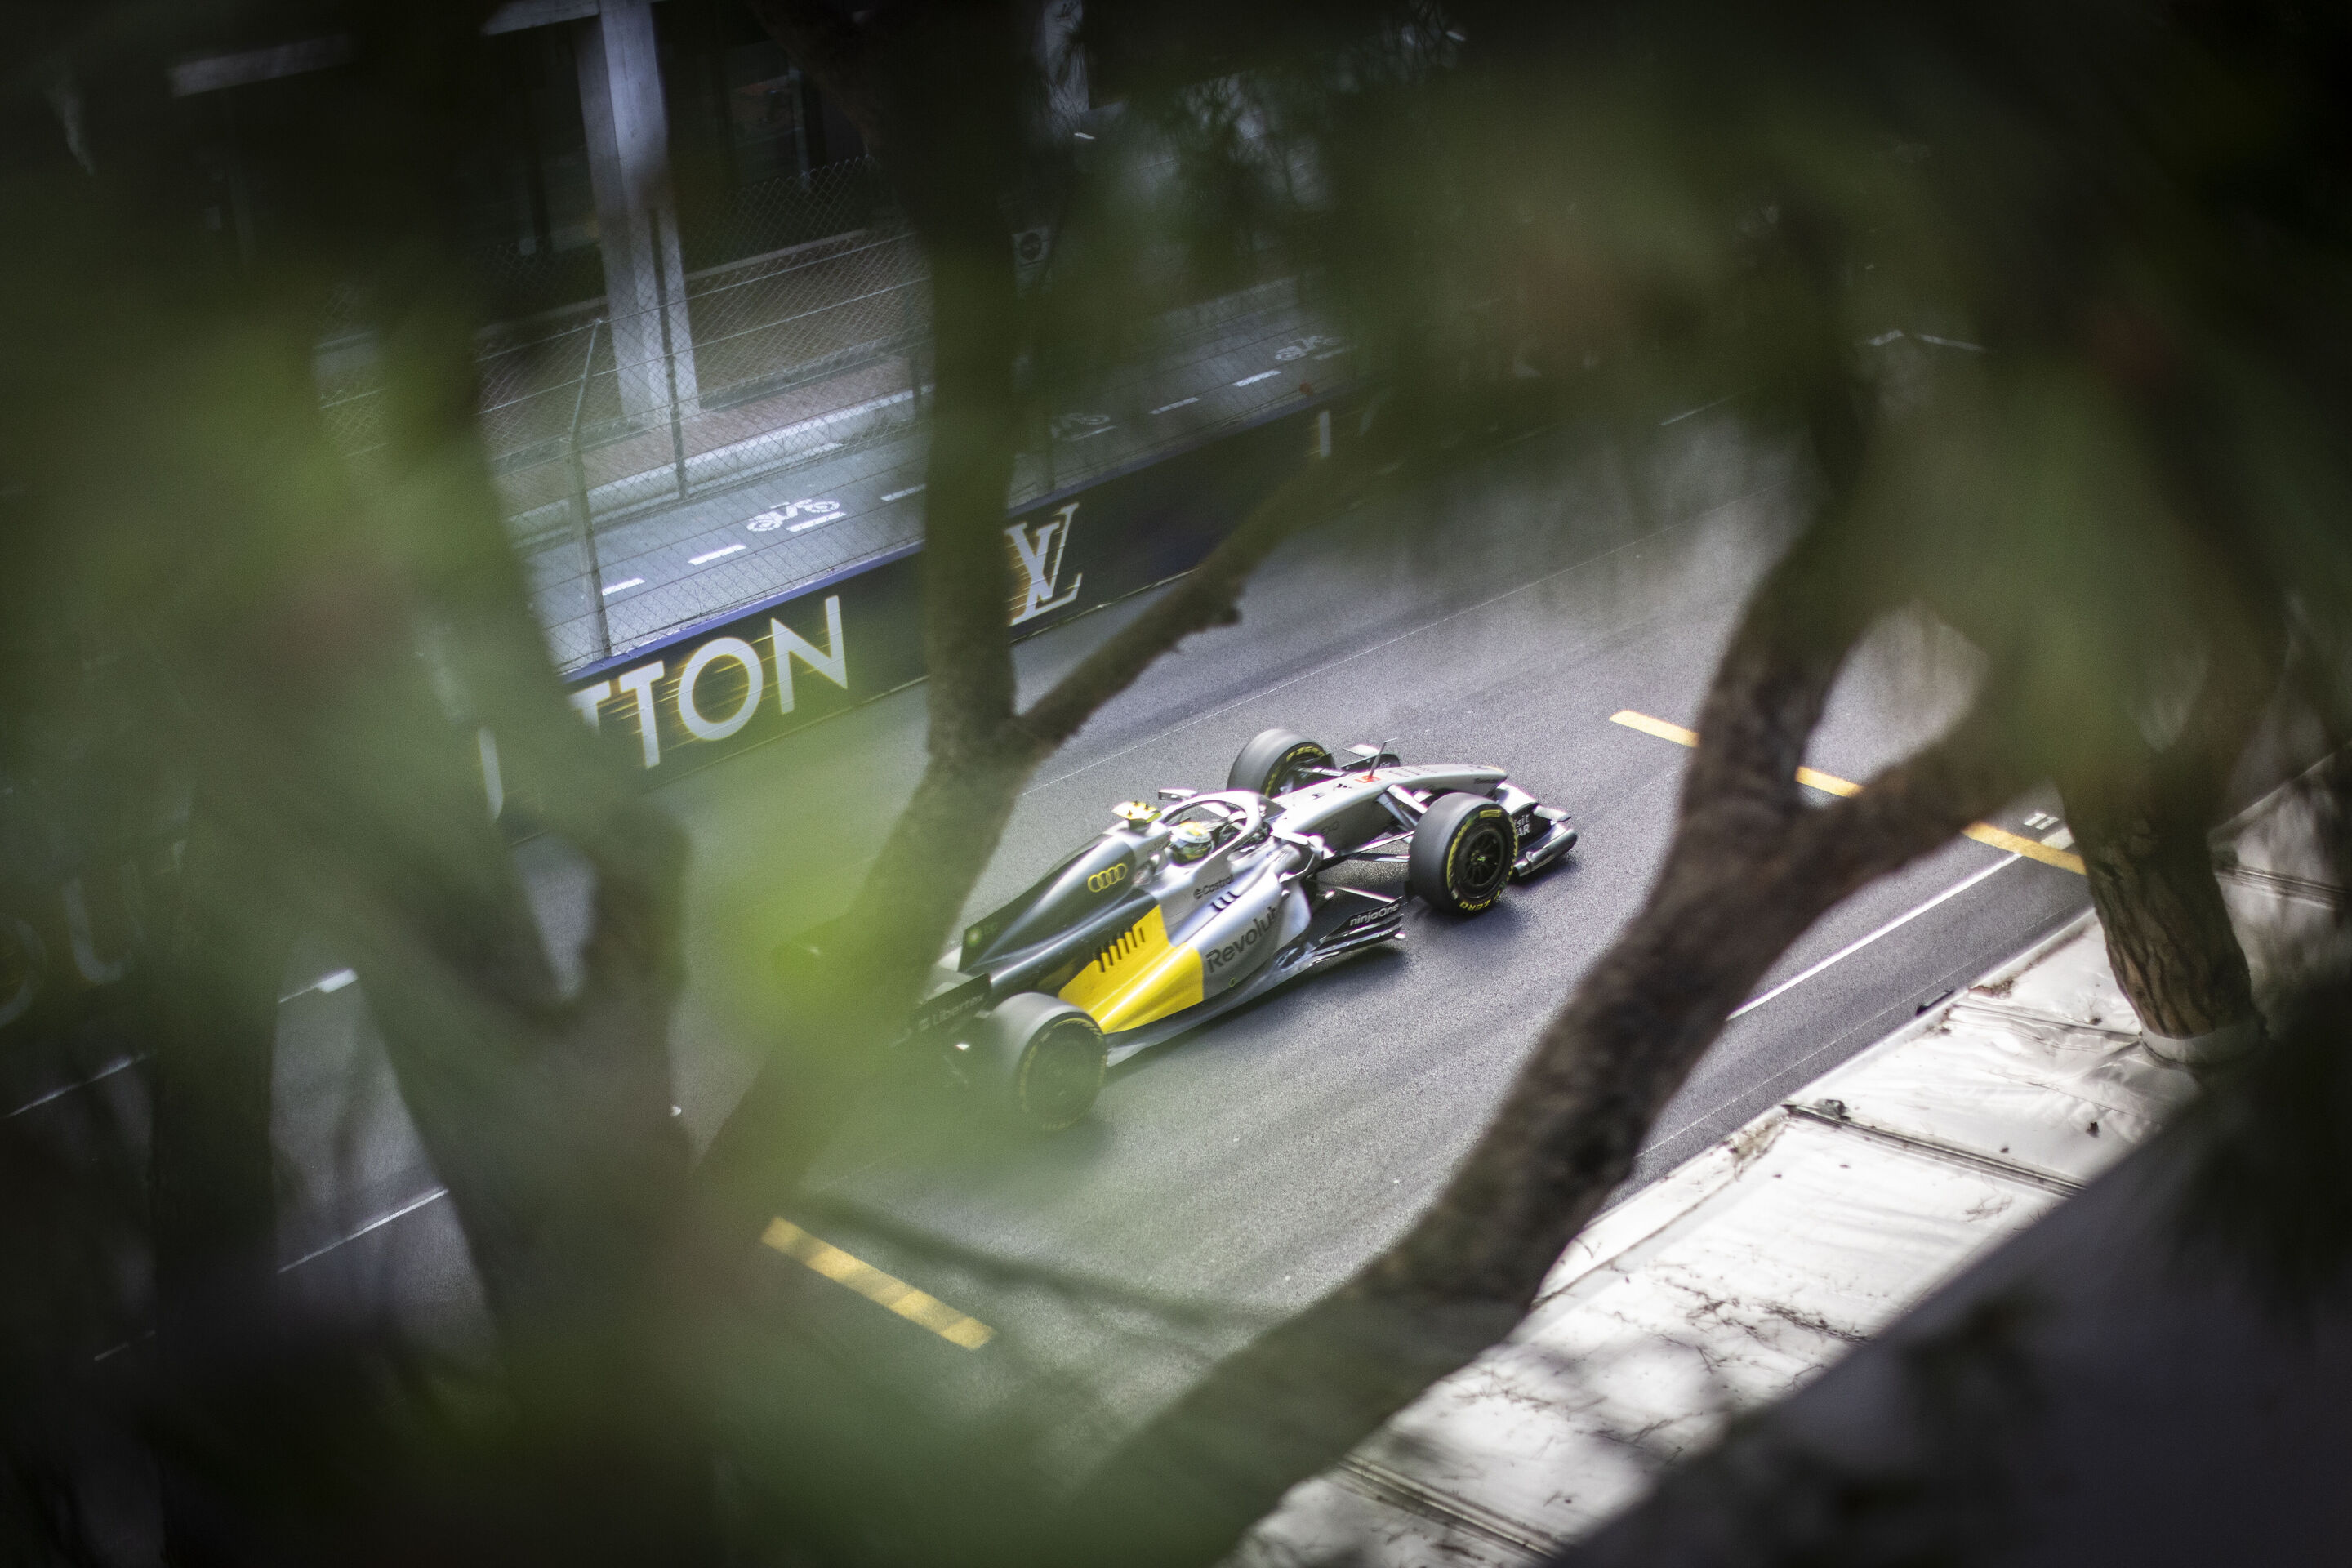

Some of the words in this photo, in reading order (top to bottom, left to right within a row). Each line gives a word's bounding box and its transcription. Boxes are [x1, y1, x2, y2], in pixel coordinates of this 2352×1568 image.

[1202, 874, 1234, 895] Castrol
[1350, 902, 1400, 926] ninjaOne
[1205, 906, 1277, 973] Revolut
